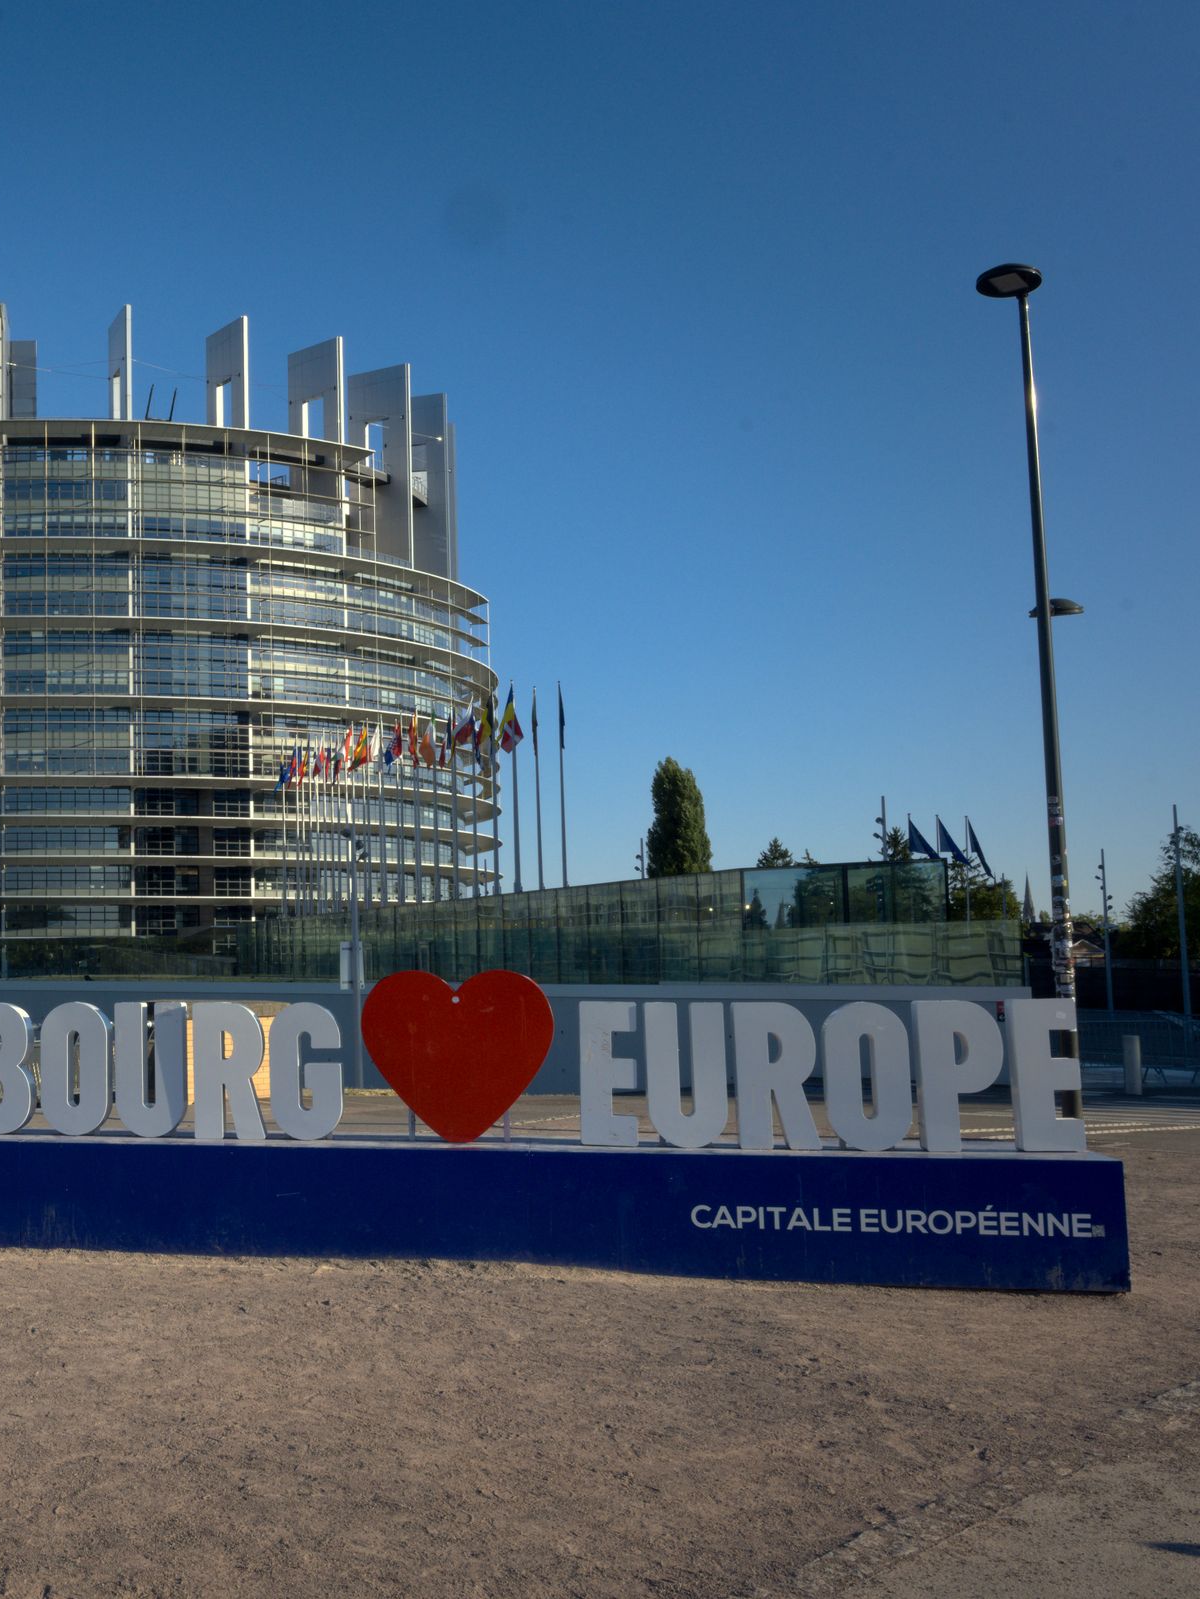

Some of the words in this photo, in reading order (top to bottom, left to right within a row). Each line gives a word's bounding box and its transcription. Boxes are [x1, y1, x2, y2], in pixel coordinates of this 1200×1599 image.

[579, 998, 1088, 1153] EUROPE
[690, 1204, 853, 1233] CAPITALE
[859, 1204, 1093, 1239] EUROPÉENNE
